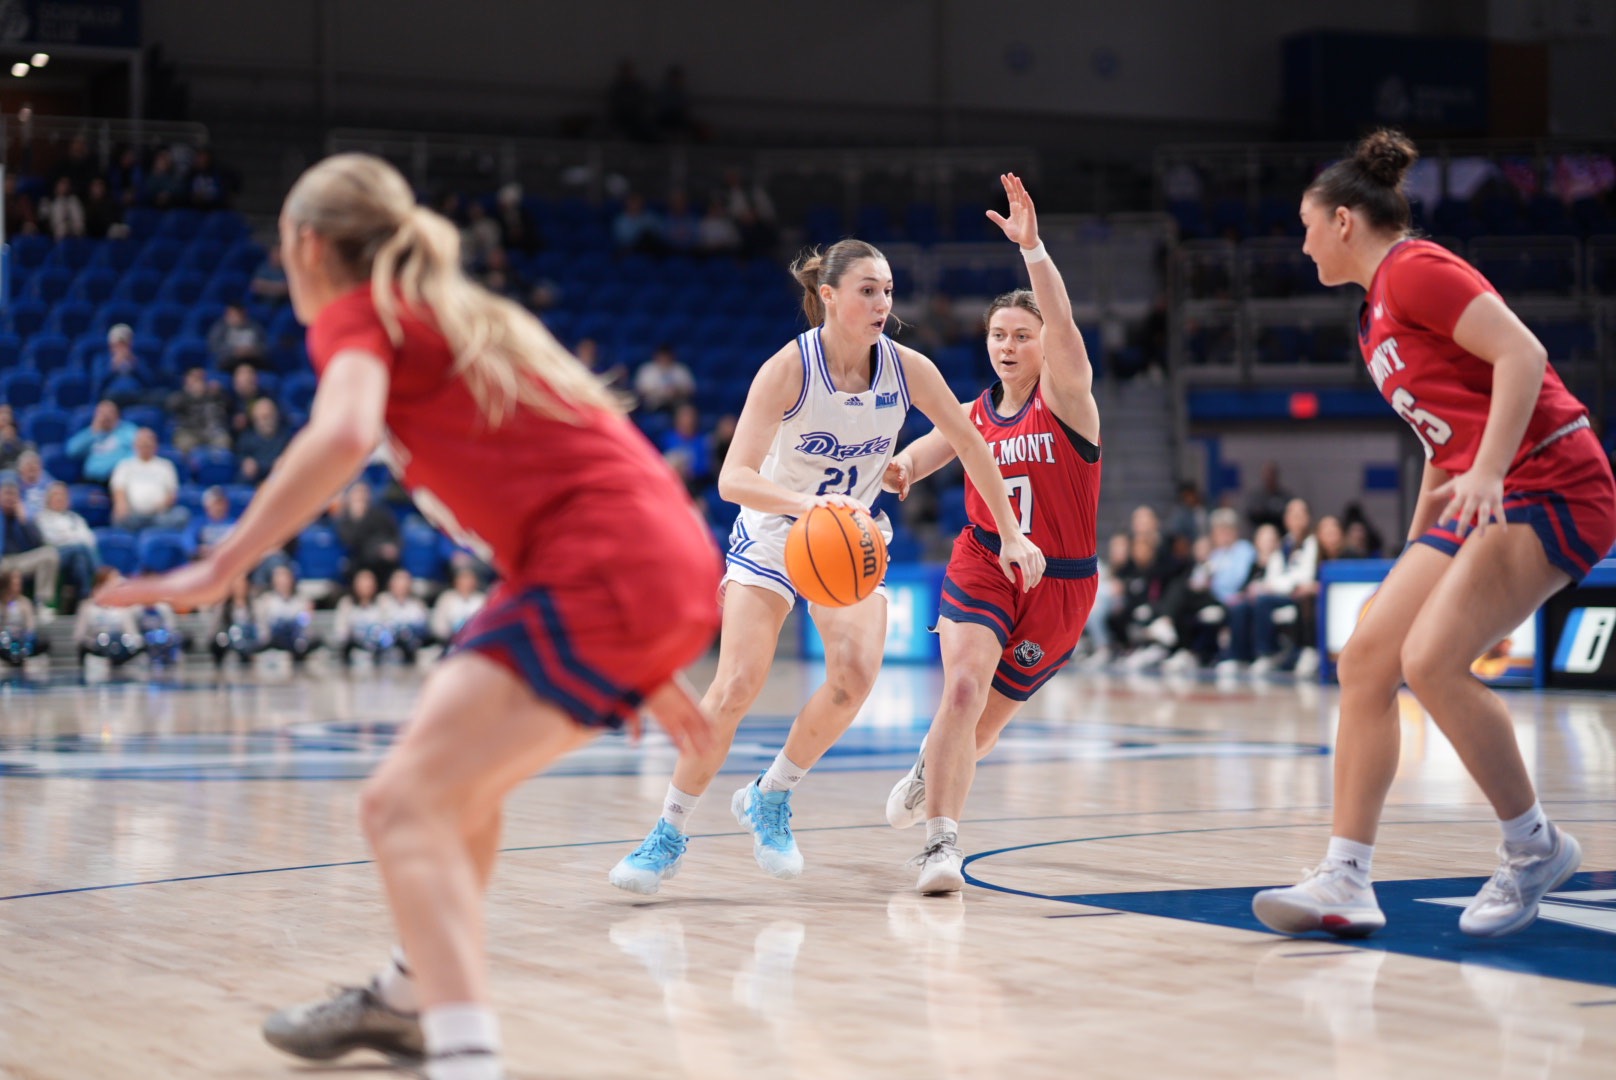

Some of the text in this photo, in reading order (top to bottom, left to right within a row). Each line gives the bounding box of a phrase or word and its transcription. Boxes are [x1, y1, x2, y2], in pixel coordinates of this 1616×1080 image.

[795, 431, 892, 462] Drake
[987, 432, 1056, 466] LMONT
[816, 465, 859, 496] 21
[850, 510, 877, 578] Wilson
